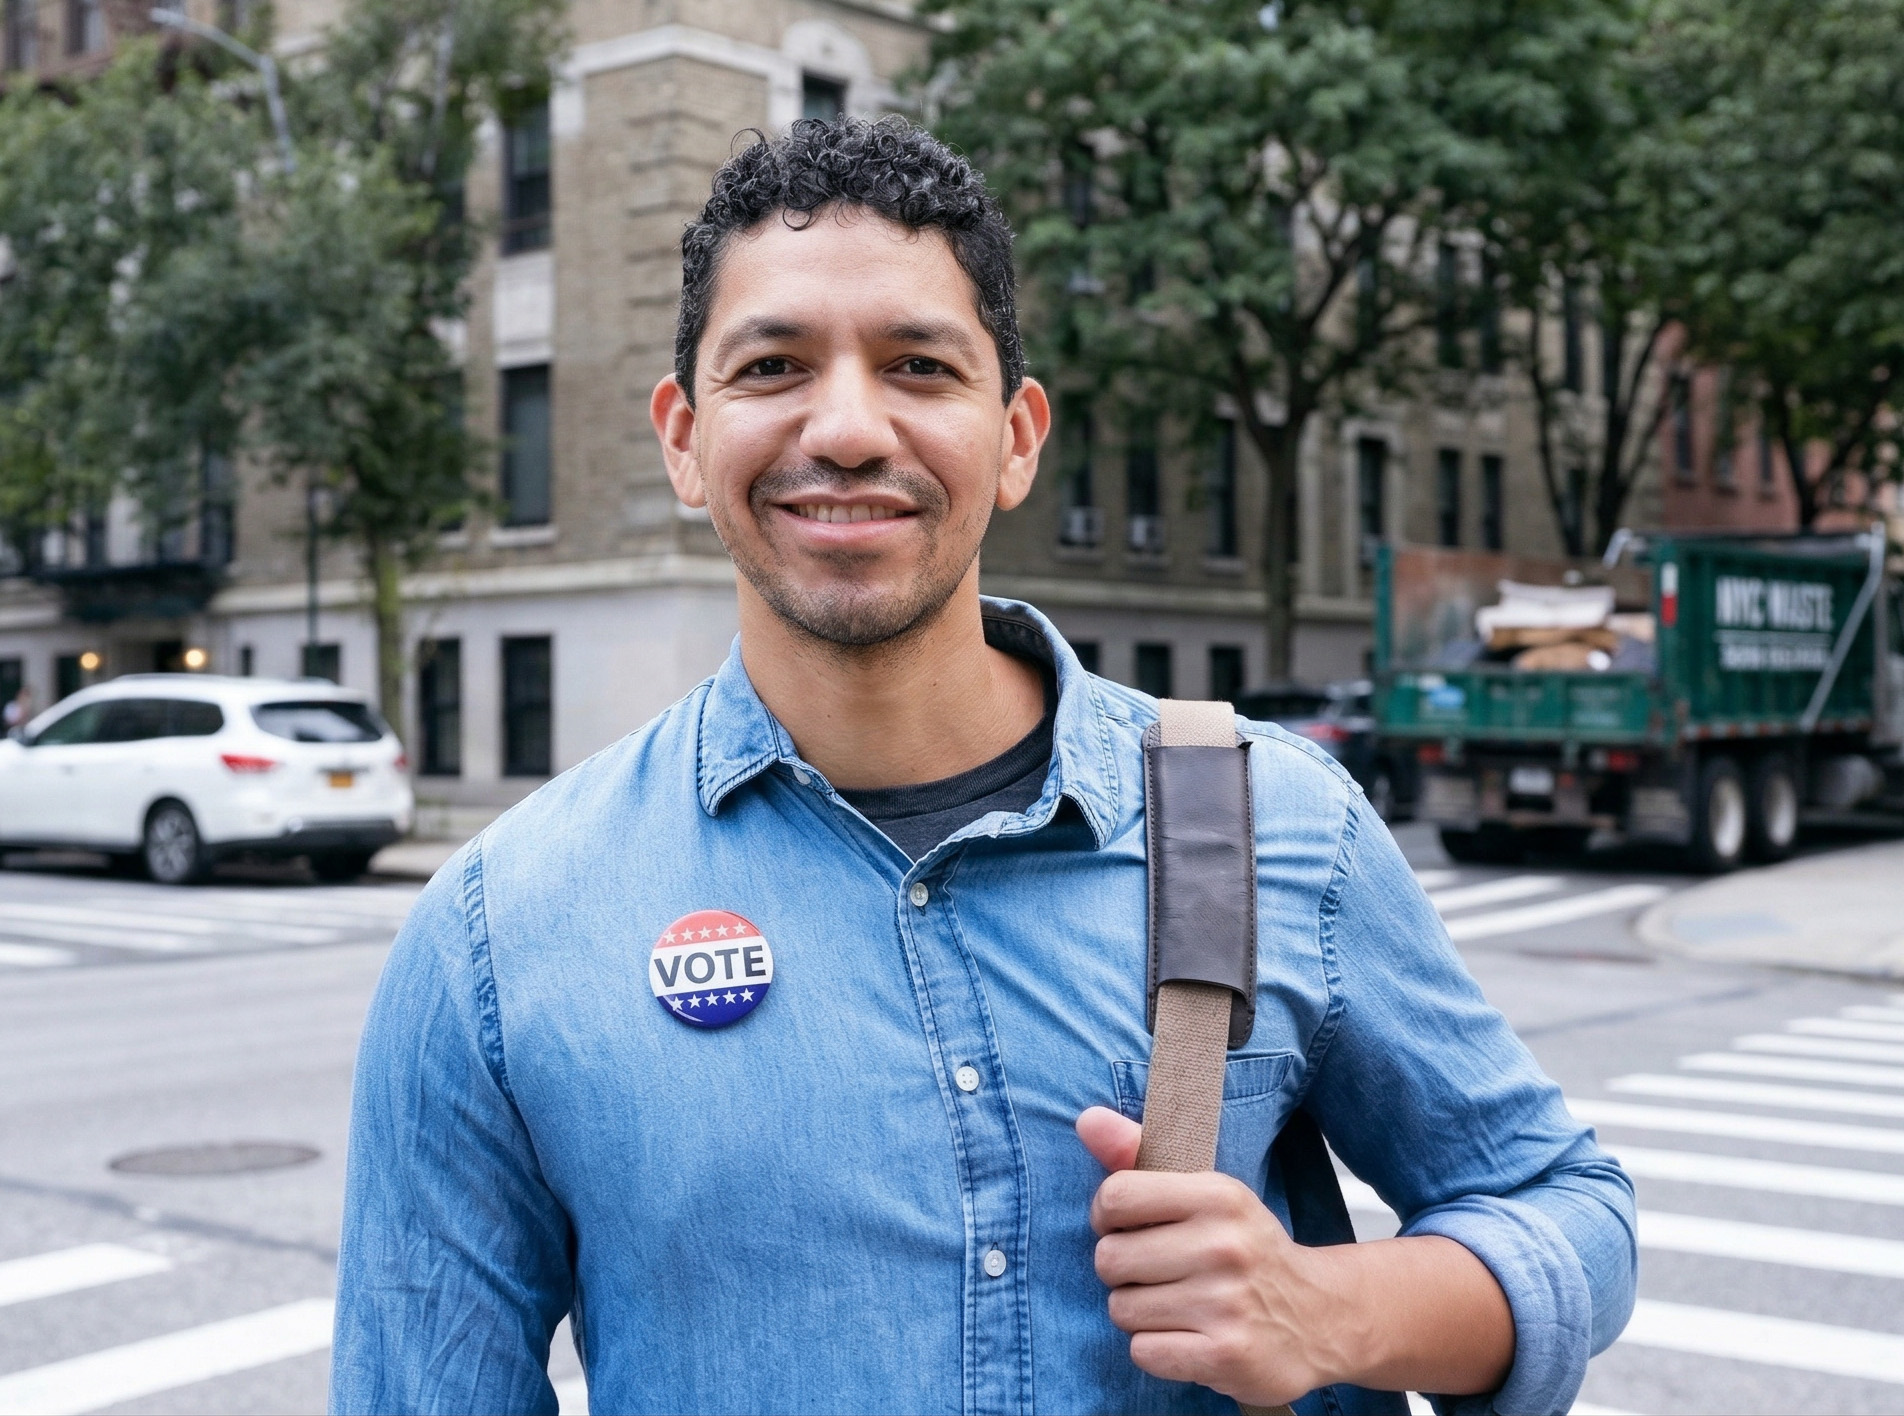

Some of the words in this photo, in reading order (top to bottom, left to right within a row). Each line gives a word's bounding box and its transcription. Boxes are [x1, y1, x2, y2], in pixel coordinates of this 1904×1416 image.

[1715, 575, 1764, 628] NYC
[1767, 579, 1834, 631] WASTE
[653, 945, 767, 988] VOTE
